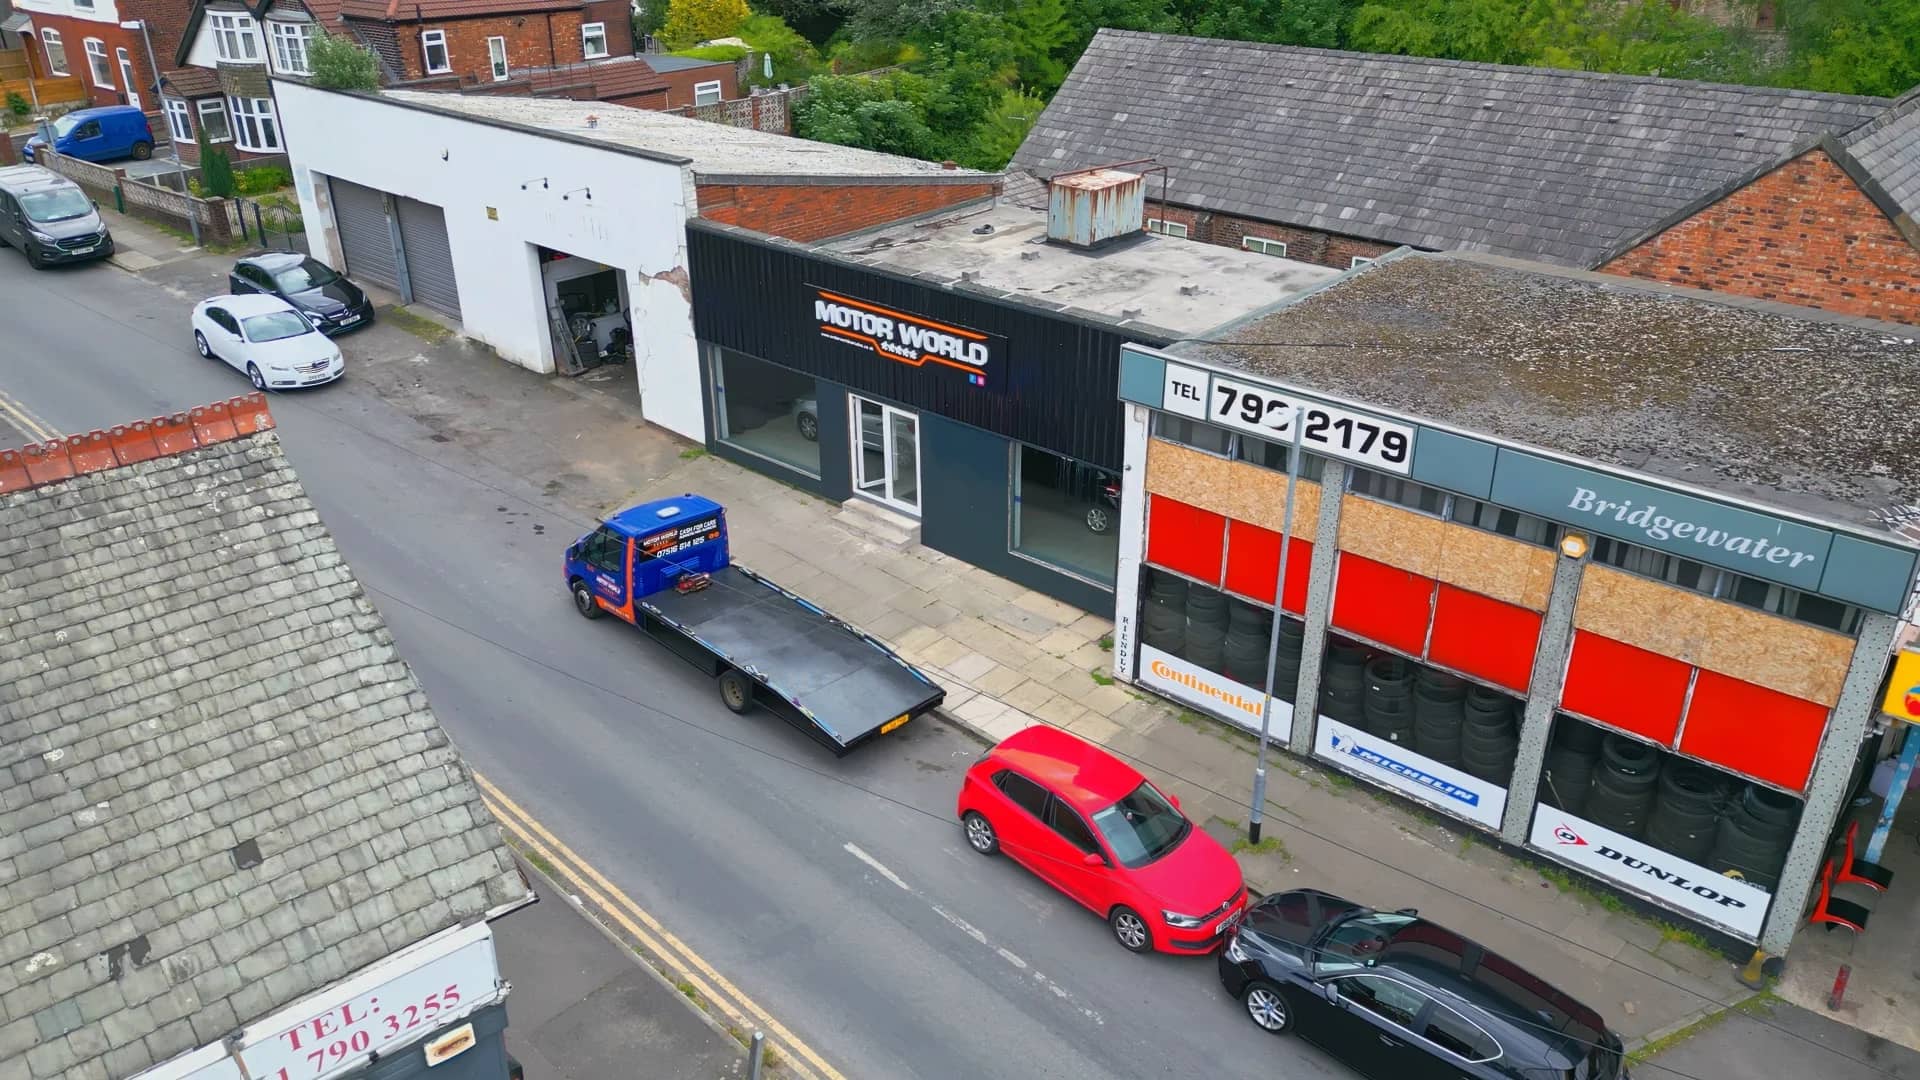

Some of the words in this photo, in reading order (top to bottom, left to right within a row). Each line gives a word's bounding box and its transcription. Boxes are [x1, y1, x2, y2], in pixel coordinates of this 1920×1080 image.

[815, 300, 893, 340] MOTOR
[898, 323, 989, 366] WORLD
[1171, 380, 1200, 401] TEL
[1305, 410, 1408, 463] 2179
[1567, 487, 1815, 568] Bridgewater
[1151, 659, 1263, 716] Continental
[1358, 750, 1476, 801] MICHELIN
[1594, 845, 1746, 909] DUNLOP
[280, 997, 381, 1052] TEL:
[307, 1030, 370, 1073] 790
[383, 984, 461, 1040] 3255
